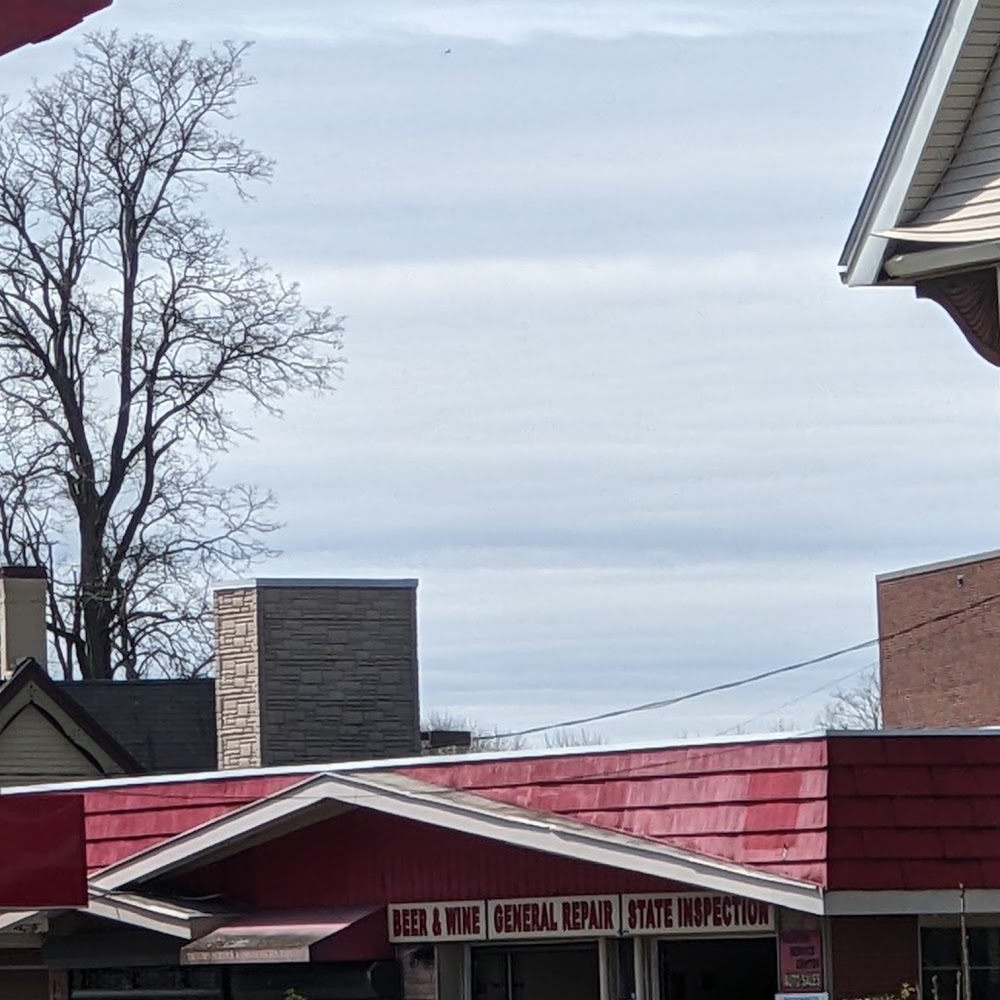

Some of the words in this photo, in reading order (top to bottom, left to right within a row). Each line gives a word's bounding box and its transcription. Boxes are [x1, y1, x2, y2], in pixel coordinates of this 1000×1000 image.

[392, 908, 429, 937] BEER
[432, 907, 442, 936] &
[445, 906, 481, 935] WINE
[493, 902, 558, 933] GENERAL
[561, 899, 615, 931] REPAIR
[627, 897, 674, 929] STATE
[677, 895, 770, 928] INSPECTION
